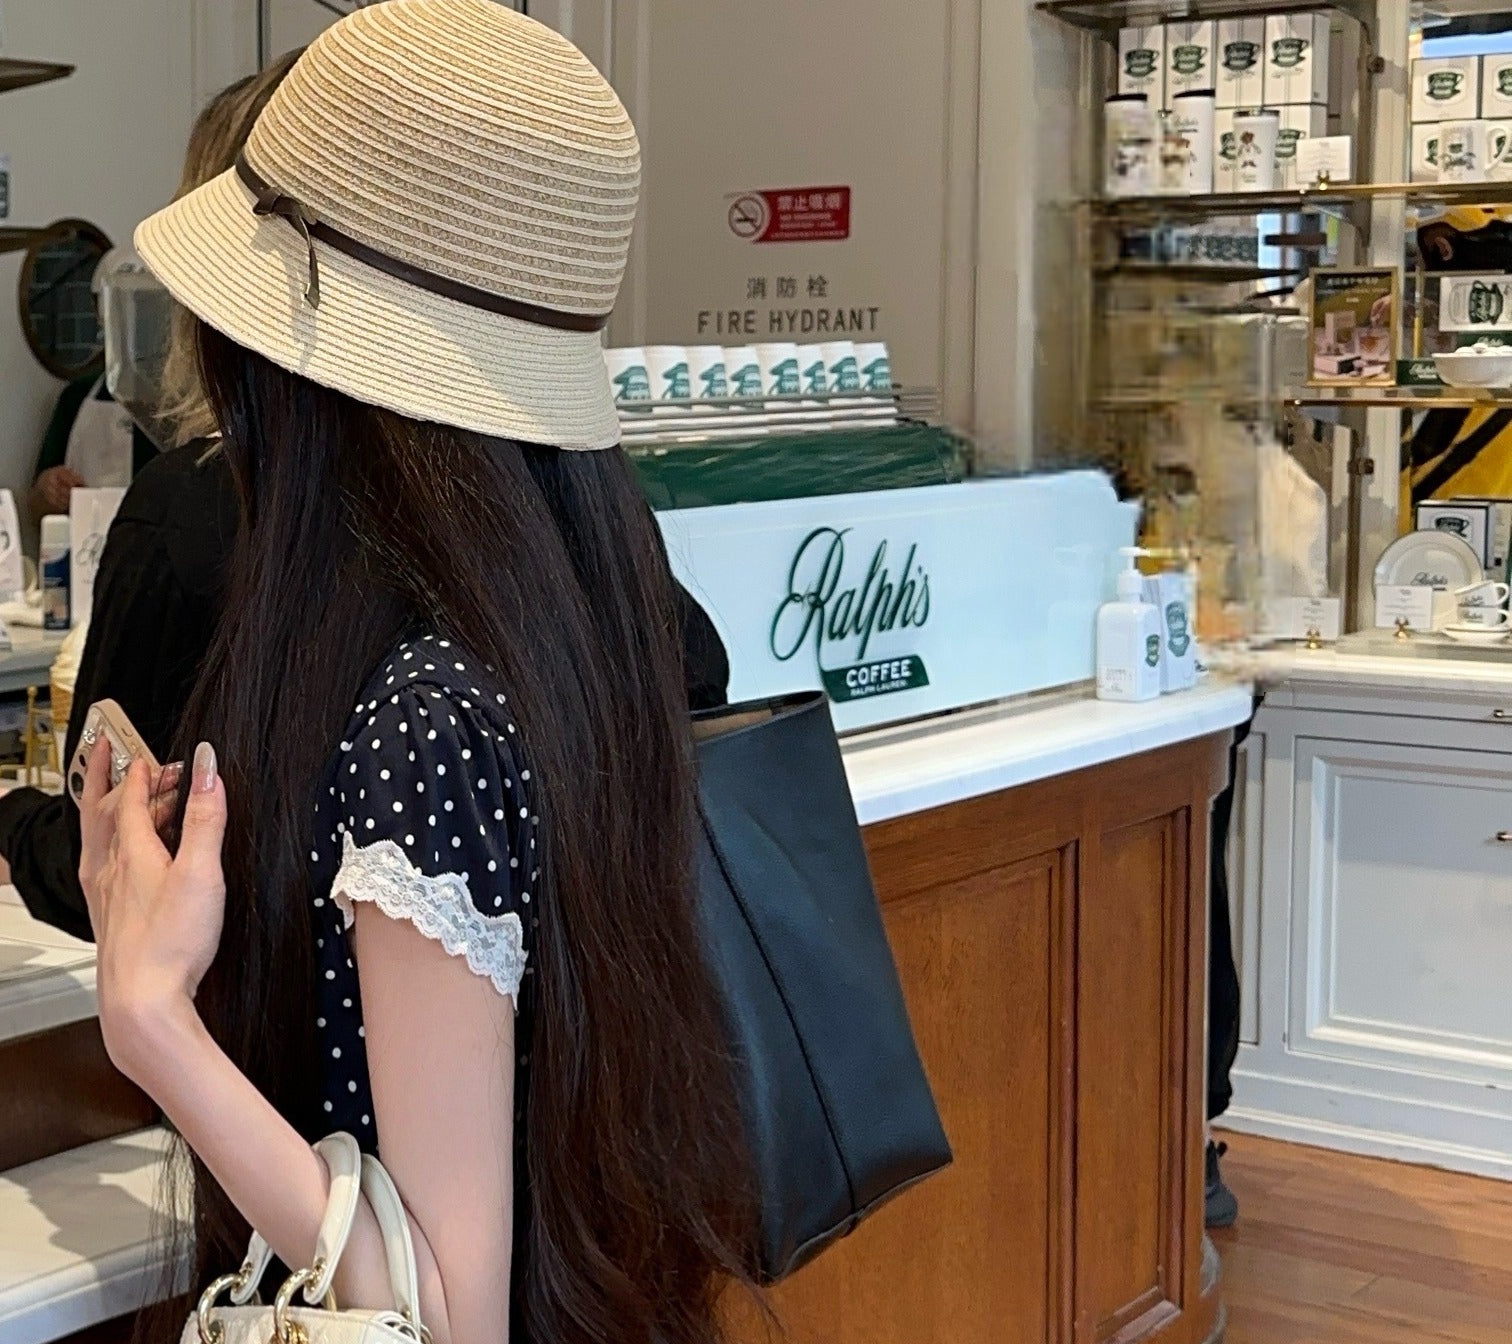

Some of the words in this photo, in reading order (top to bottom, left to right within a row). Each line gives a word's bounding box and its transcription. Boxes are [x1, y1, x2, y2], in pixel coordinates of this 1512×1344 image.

[746, 274, 829, 300] 消防栓
[696, 309, 758, 335] FIRE
[769, 306, 880, 334] HYDRANT
[770, 526, 930, 663] Ralph's
[846, 658, 913, 689] COFFEE
